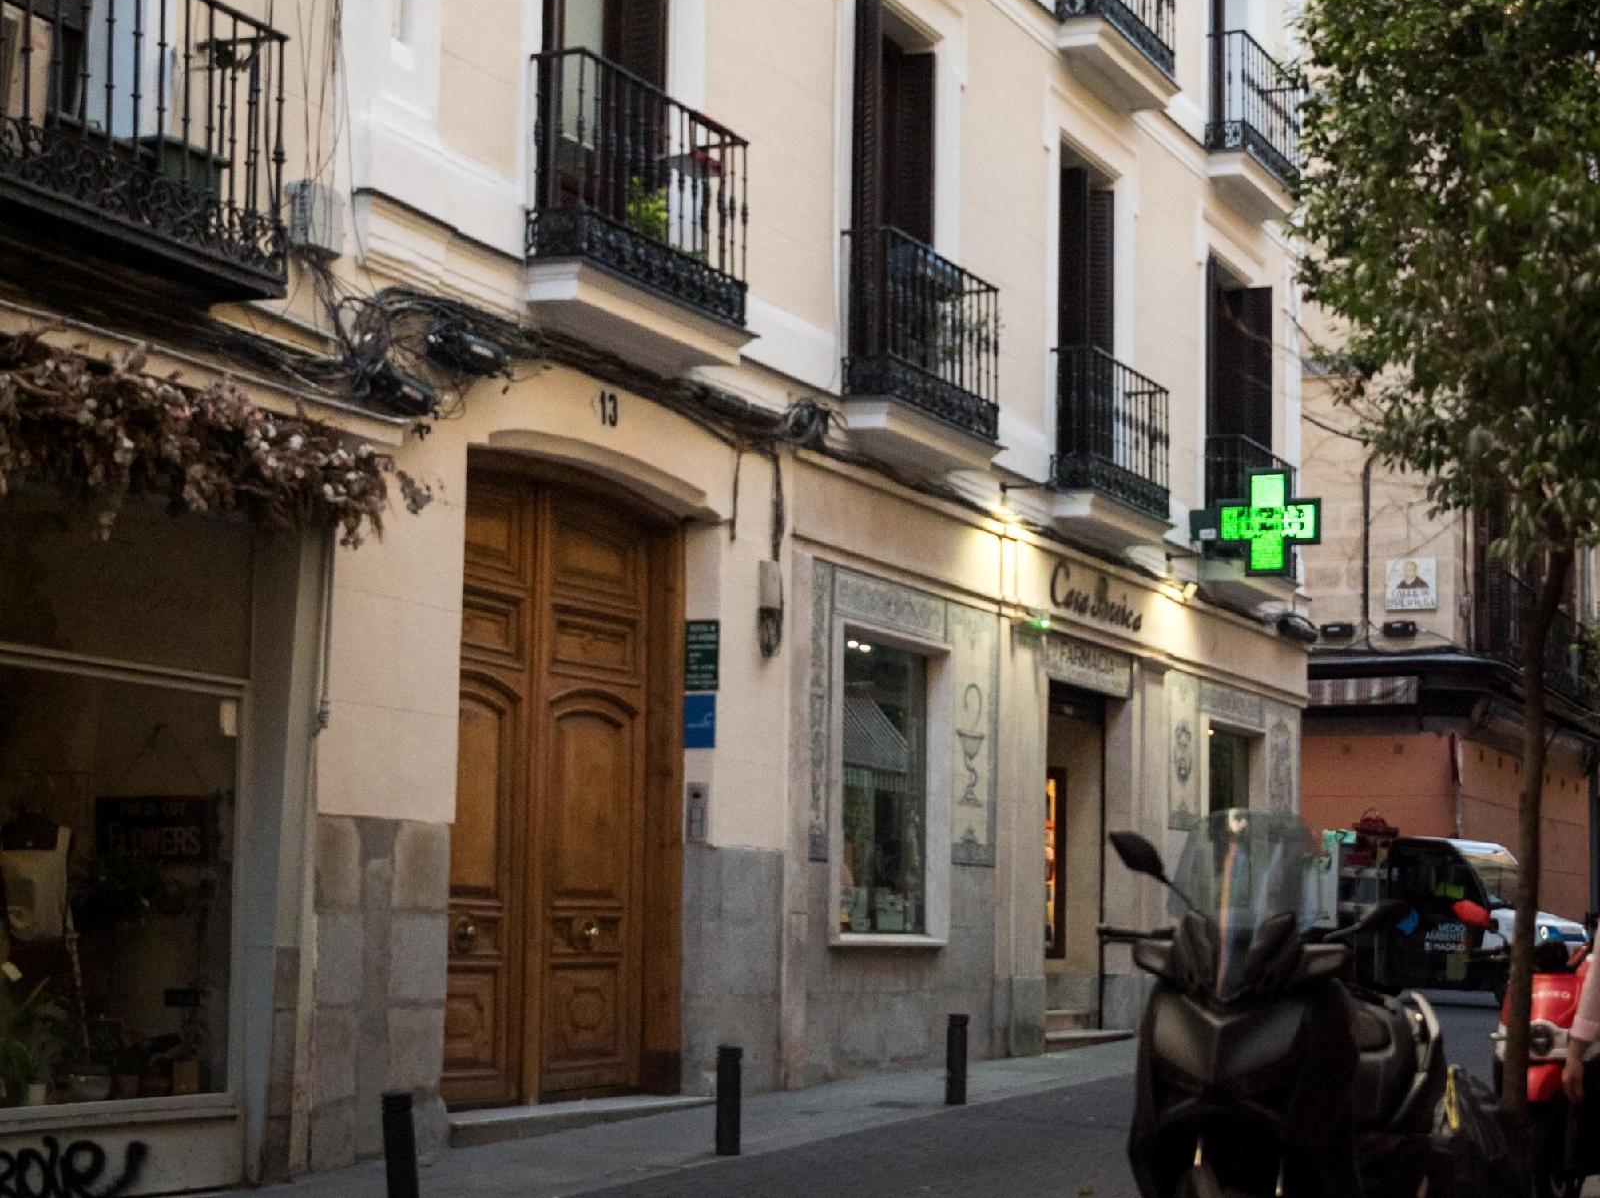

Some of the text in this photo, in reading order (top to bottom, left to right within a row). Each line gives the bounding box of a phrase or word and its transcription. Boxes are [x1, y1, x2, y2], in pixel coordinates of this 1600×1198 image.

[600, 391, 618, 427] 13
[1438, 923, 1466, 931] MEDIO
[1425, 931, 1466, 942] AMBIENTE
[1433, 942, 1466, 951] MADRID
